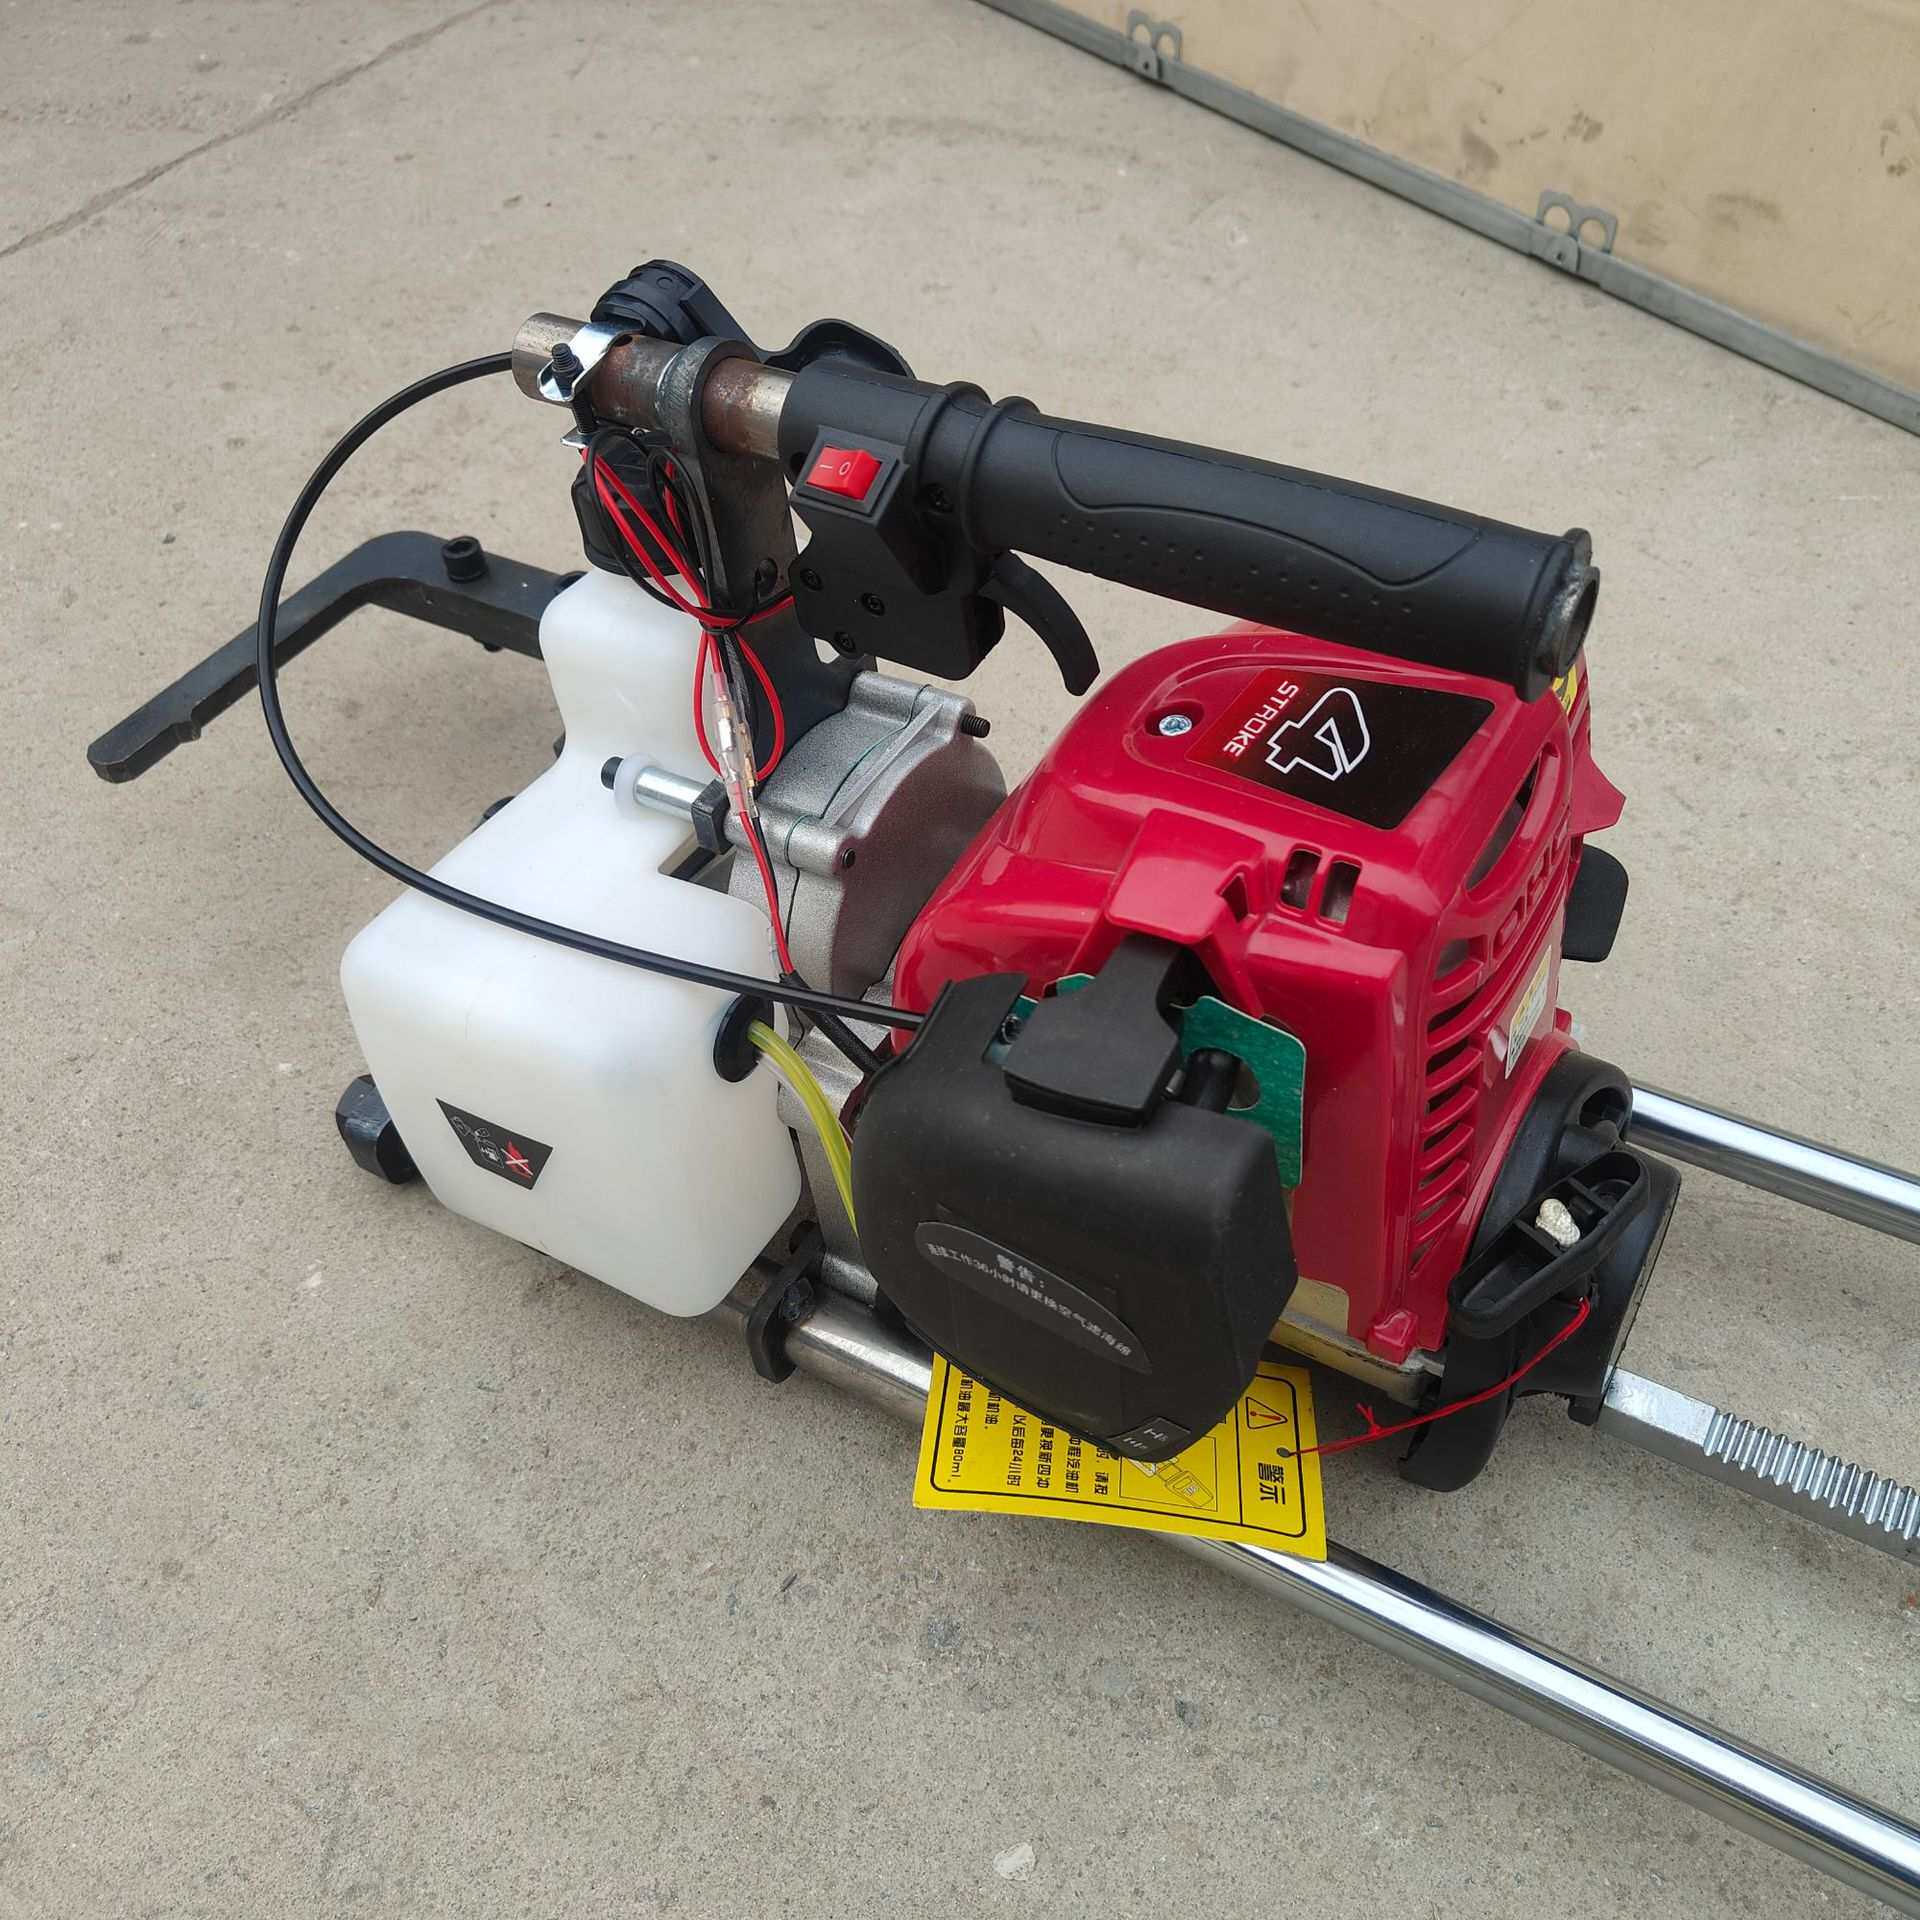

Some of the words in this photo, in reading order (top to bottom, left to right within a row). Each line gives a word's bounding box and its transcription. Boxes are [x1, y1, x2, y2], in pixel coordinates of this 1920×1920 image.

[1223, 680, 1299, 757] STROKE
[1265, 687, 1371, 781] 4
[1037, 1420, 1055, 1489] 更换新四冲
[1257, 1462, 1286, 1505] 警示
